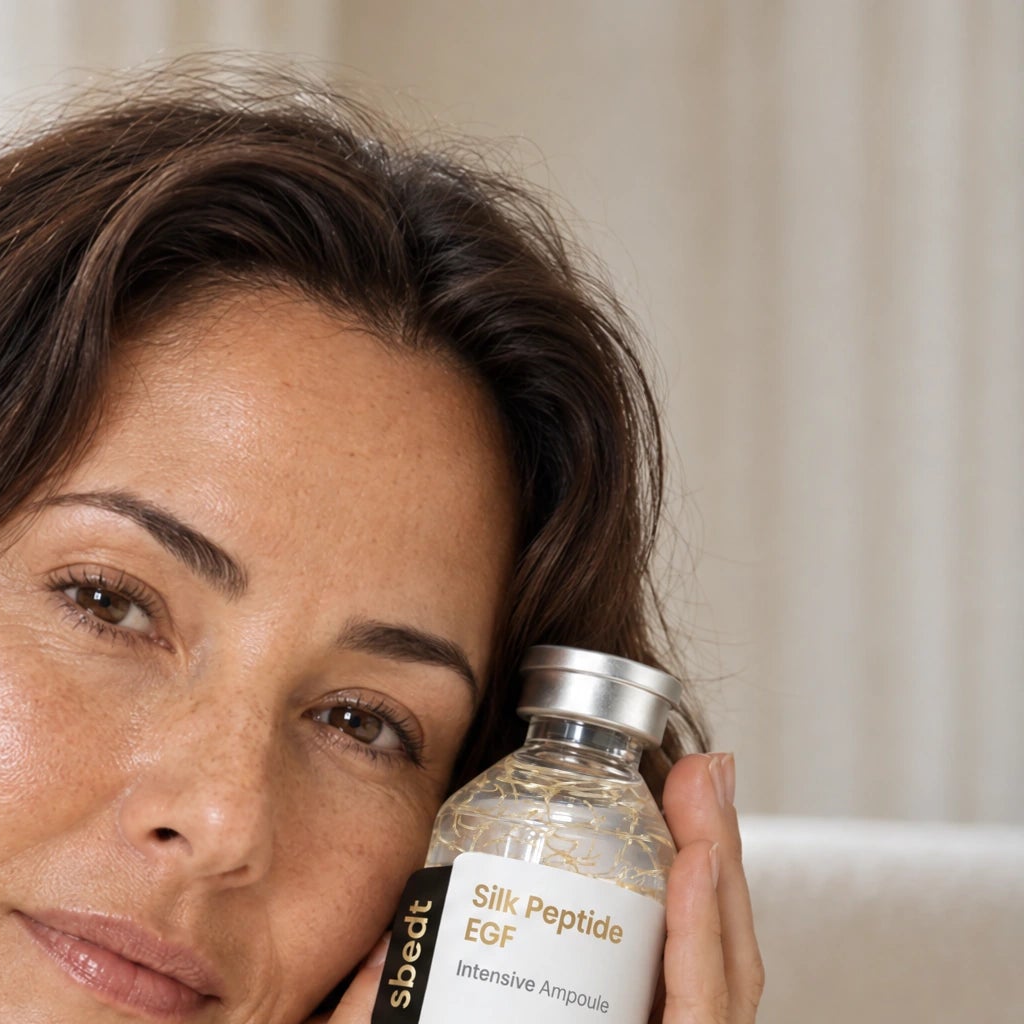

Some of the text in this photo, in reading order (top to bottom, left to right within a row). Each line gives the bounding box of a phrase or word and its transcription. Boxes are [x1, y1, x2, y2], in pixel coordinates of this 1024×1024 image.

[464, 918, 516, 948] EGF
[472, 883, 624, 945] Silk Peptide
[388, 899, 433, 1009] sbedt
[456, 960, 610, 1014] Intensive Ampoule
